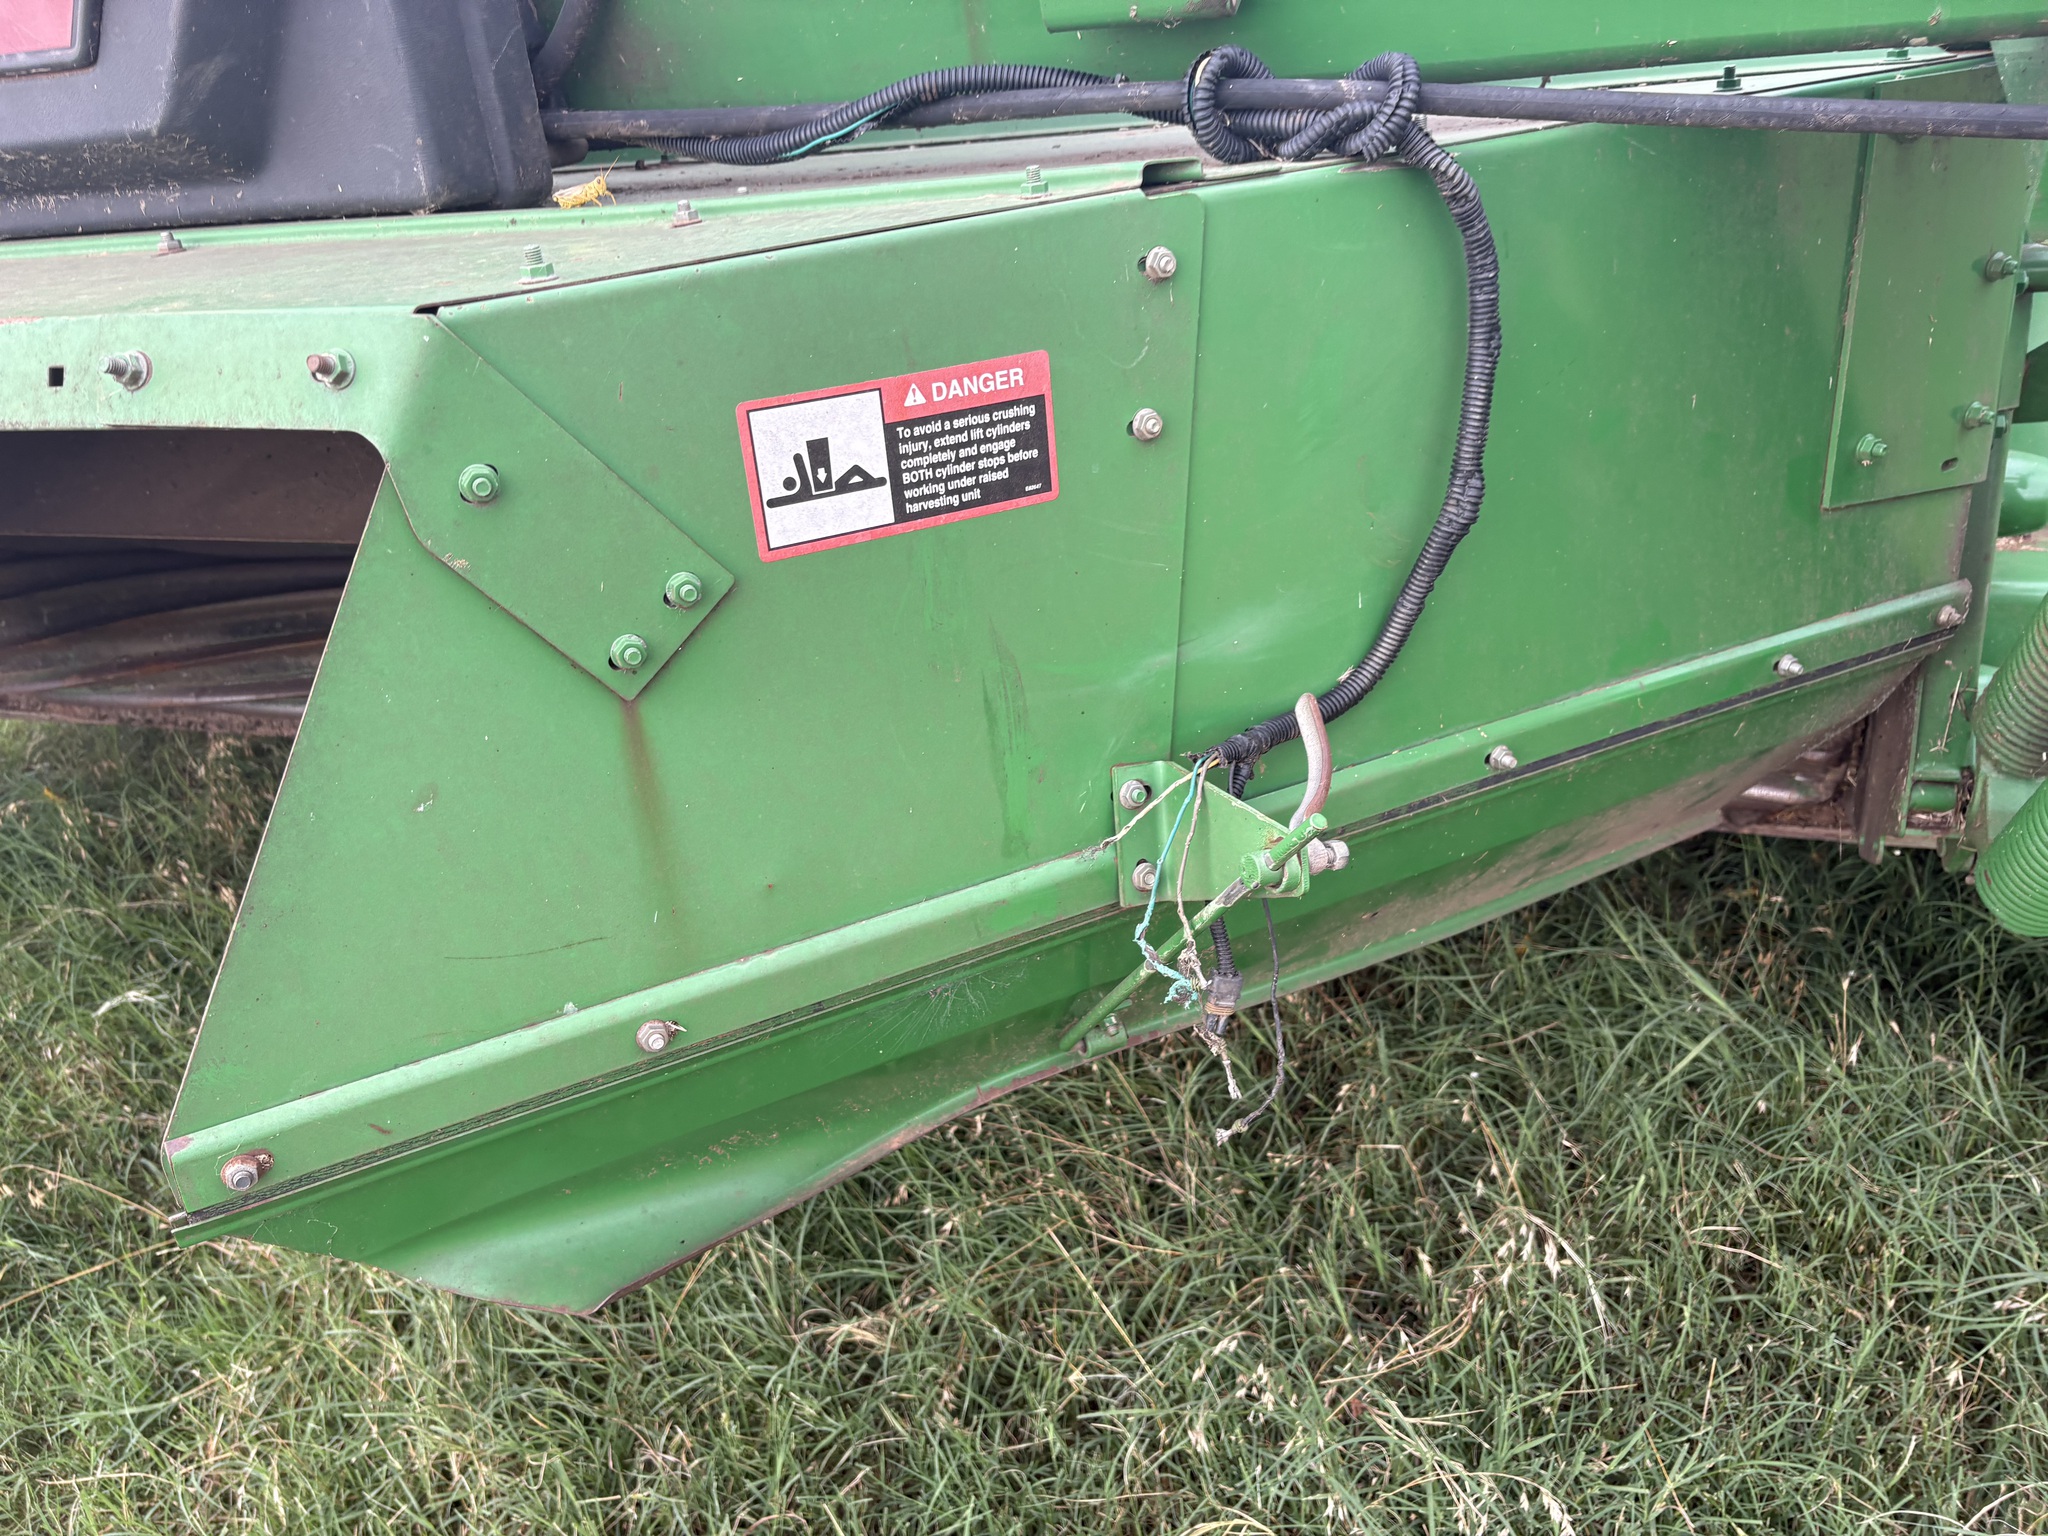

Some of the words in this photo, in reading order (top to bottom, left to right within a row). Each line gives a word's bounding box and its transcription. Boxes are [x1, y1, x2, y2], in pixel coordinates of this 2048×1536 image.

[932, 367, 1024, 402] DANGER
[896, 427, 911, 439] To
[913, 421, 942, 436] avoid
[943, 421, 951, 431] a
[952, 413, 991, 429] serious
[992, 404, 1036, 420] crushing
[898, 439, 933, 456] injury,
[934, 431, 969, 449] extend
[970, 428, 984, 441] lift
[985, 420, 1031, 439] cylinders
[900, 448, 957, 470] completely
[958, 444, 978, 458] and
[979, 438, 1016, 455] engage
[902, 467, 934, 485] BOTH
[935, 459, 976, 480] cylinder
[978, 454, 1006, 469] stops
[1007, 447, 1039, 463] before
[903, 481, 946, 500] working
[947, 475, 976, 491] under
[979, 467, 1009, 484] raised
[905, 495, 960, 514] harvesting
[962, 488, 981, 502] unit
